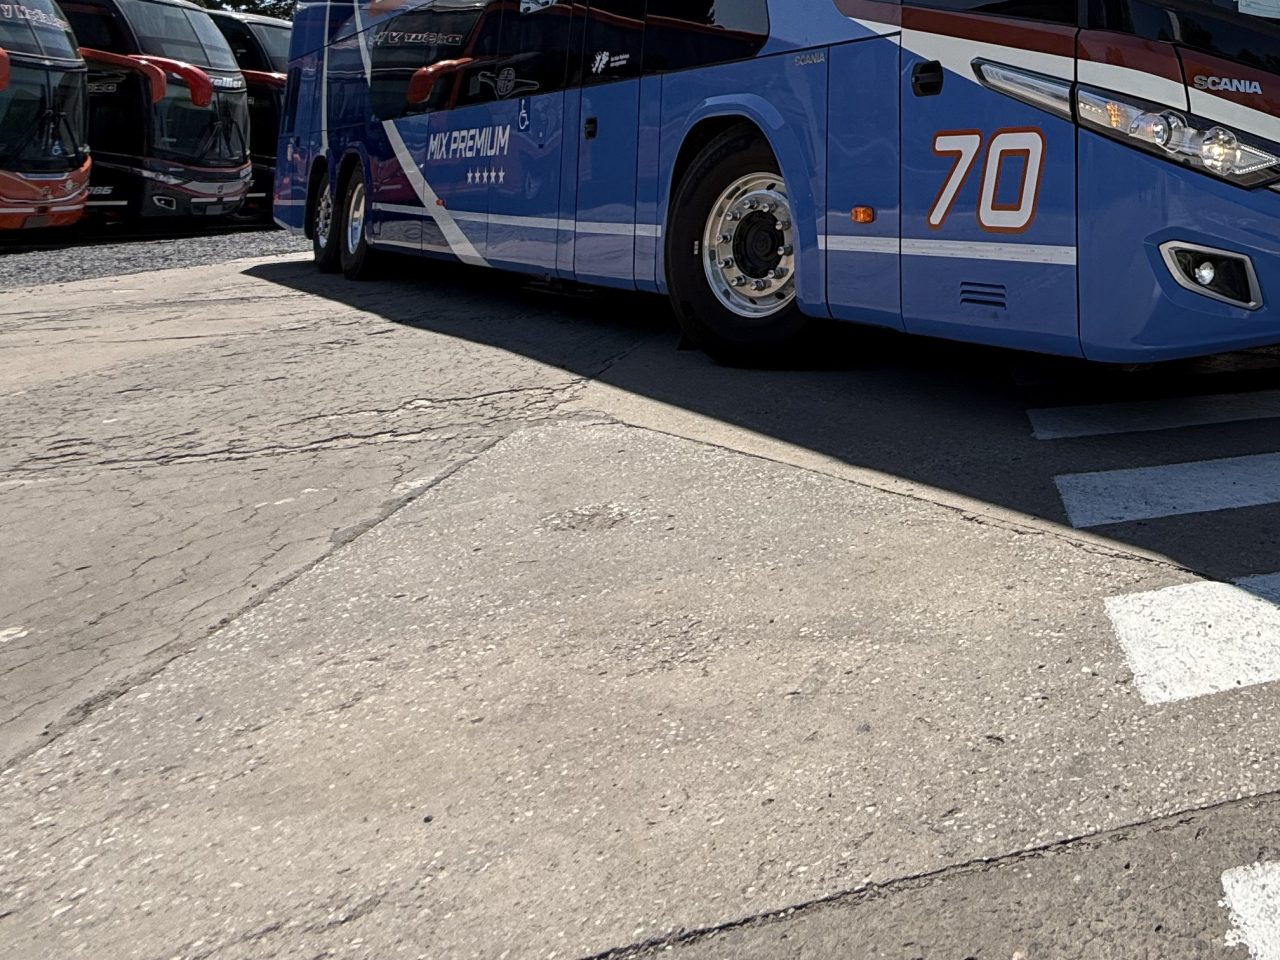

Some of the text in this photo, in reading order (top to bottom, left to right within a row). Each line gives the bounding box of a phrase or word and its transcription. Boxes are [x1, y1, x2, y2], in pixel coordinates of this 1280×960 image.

[794, 49, 825, 66] SCANIA
[1193, 75, 1263, 95] SCANIA
[427, 125, 511, 160] MIX PREMIUM
[927, 128, 1045, 232] 70
